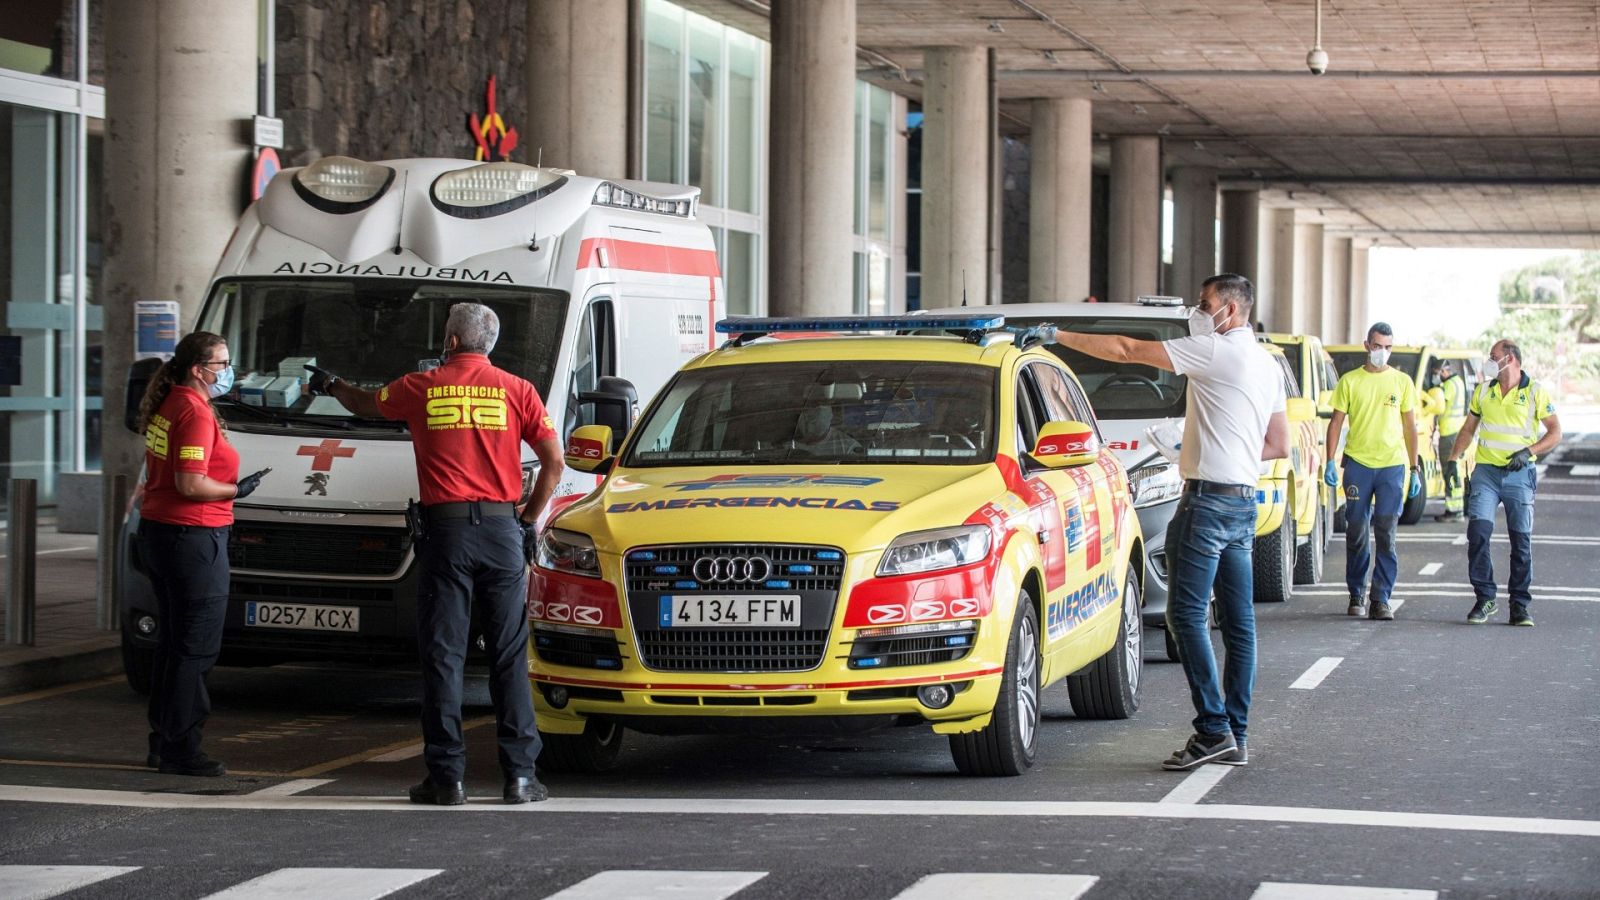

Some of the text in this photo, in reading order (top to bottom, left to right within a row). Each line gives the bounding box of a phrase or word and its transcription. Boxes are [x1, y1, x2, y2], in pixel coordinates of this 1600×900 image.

[427, 385, 506, 399] EMERGENCIAS
[606, 496, 900, 513] EMERGENCIAS
[678, 600, 738, 622] 4134
[747, 600, 794, 622] FFM
[1047, 568, 1120, 640] EMERGENCIAS
[258, 604, 307, 626] 0257
[314, 608, 353, 629] KCX
